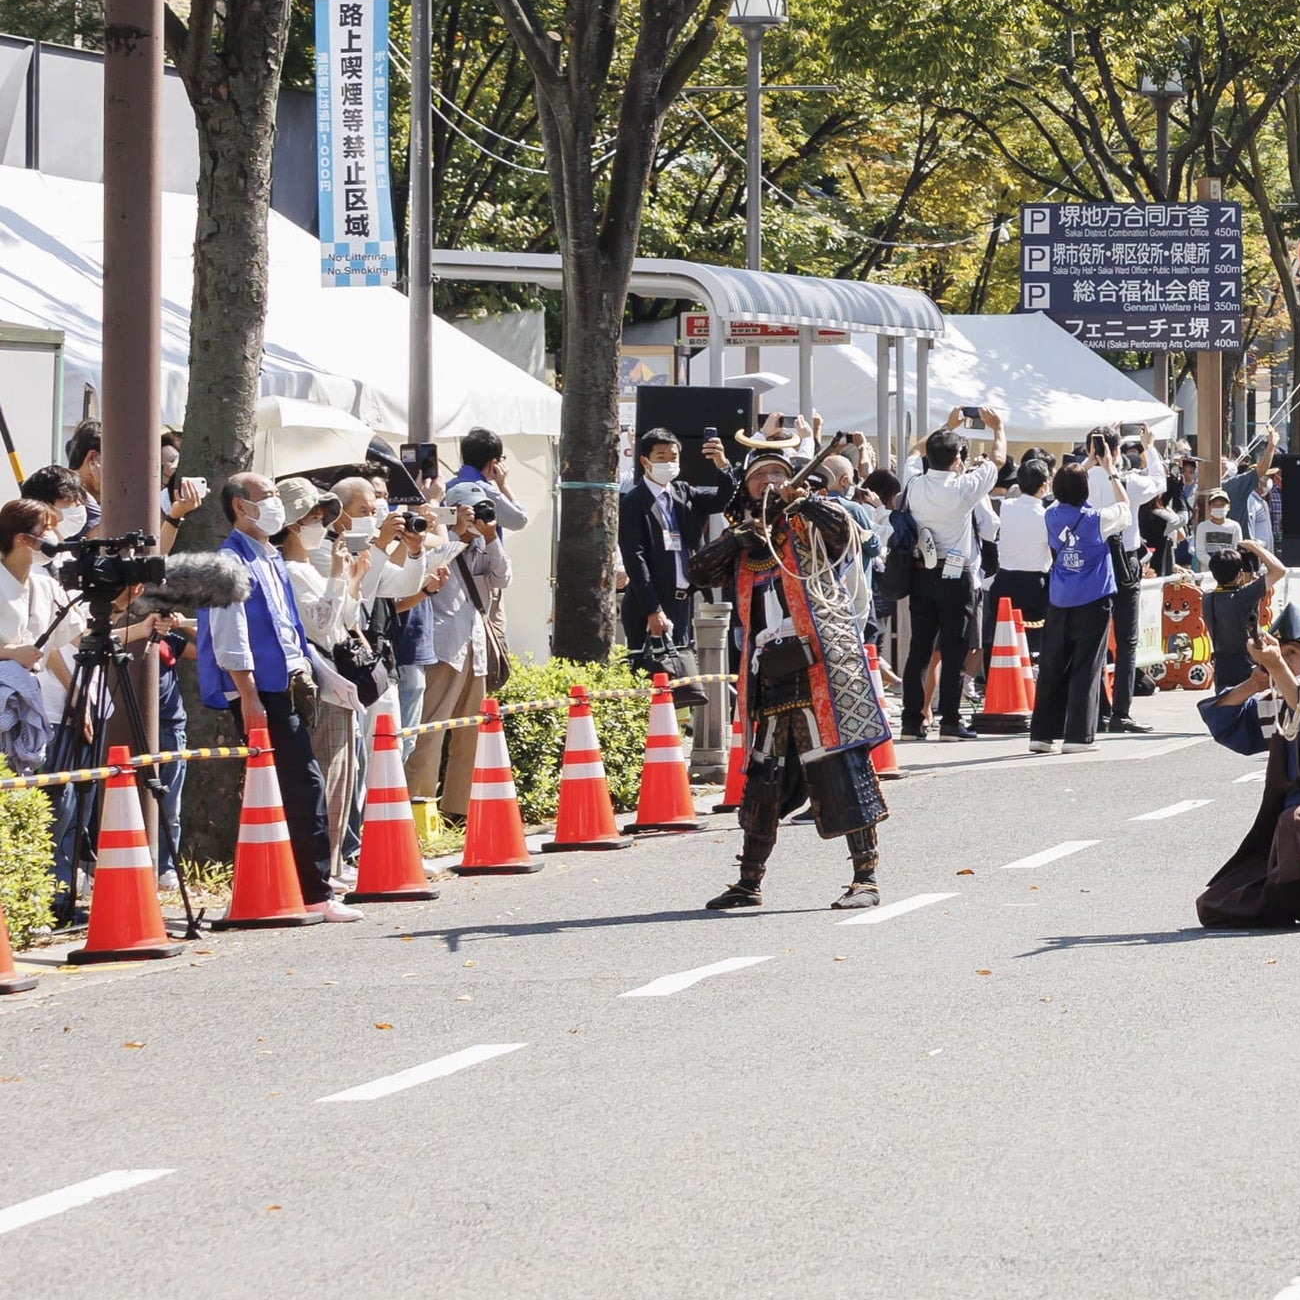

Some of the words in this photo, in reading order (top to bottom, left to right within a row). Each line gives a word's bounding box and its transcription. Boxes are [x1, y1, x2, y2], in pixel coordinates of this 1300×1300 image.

[338, 3, 370, 238] 路上喫煙等禁止区域
[1030, 210, 1046, 232] P
[1058, 205, 1210, 228] 堺地方合同庁舎
[1064, 228, 1084, 238] Sakai
[1084, 228, 1107, 238] District
[1108, 228, 1149, 238] Combination
[1190, 228, 1210, 237] Office
[1214, 228, 1240, 238] 450m
[328, 252, 341, 262] No
[344, 251, 388, 265] Littering
[1029, 248, 1046, 270] P
[327, 266, 341, 275] No
[344, 264, 389, 277] Smoking
[1214, 265, 1240, 274] 500m
[1029, 285, 1046, 307] P
[1072, 279, 1210, 303] 総合福祉会館
[1123, 303, 1158, 312] General
[1159, 303, 1191, 312] Welfare
[1194, 303, 1210, 312] Hall
[1214, 302, 1240, 312] 350m
[1065, 317, 1210, 338] フェニーチェ堺
[1126, 340, 1168, 350] Performing
[1169, 340, 1183, 348] Arts
[1214, 339, 1240, 348] 400m
